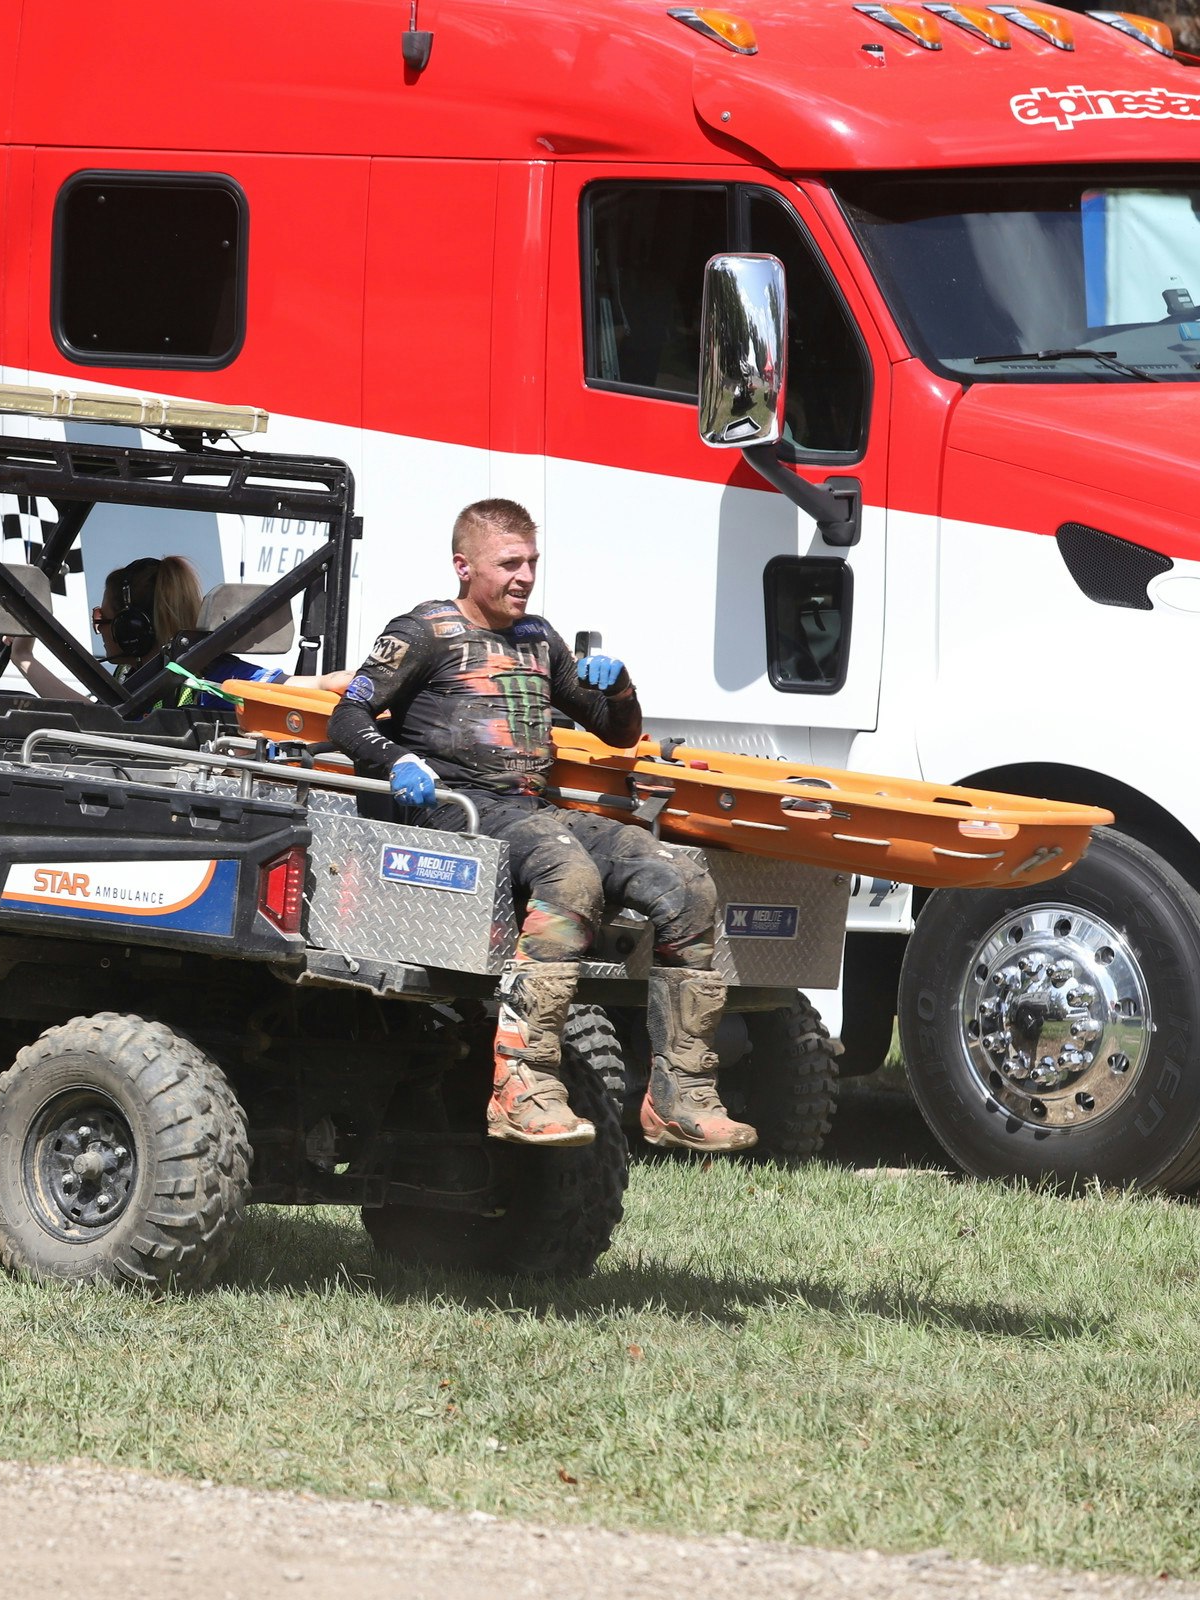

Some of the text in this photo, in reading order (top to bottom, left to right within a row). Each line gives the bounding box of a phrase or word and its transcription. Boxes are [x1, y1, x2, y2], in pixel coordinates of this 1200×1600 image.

[261, 516, 330, 536] MOBIL
[417, 856, 458, 873] MEDLITE
[416, 867, 455, 881] TRANSPORT
[33, 868, 165, 905] STAR AMBULANCE
[752, 910, 784, 922] MEDLITE
